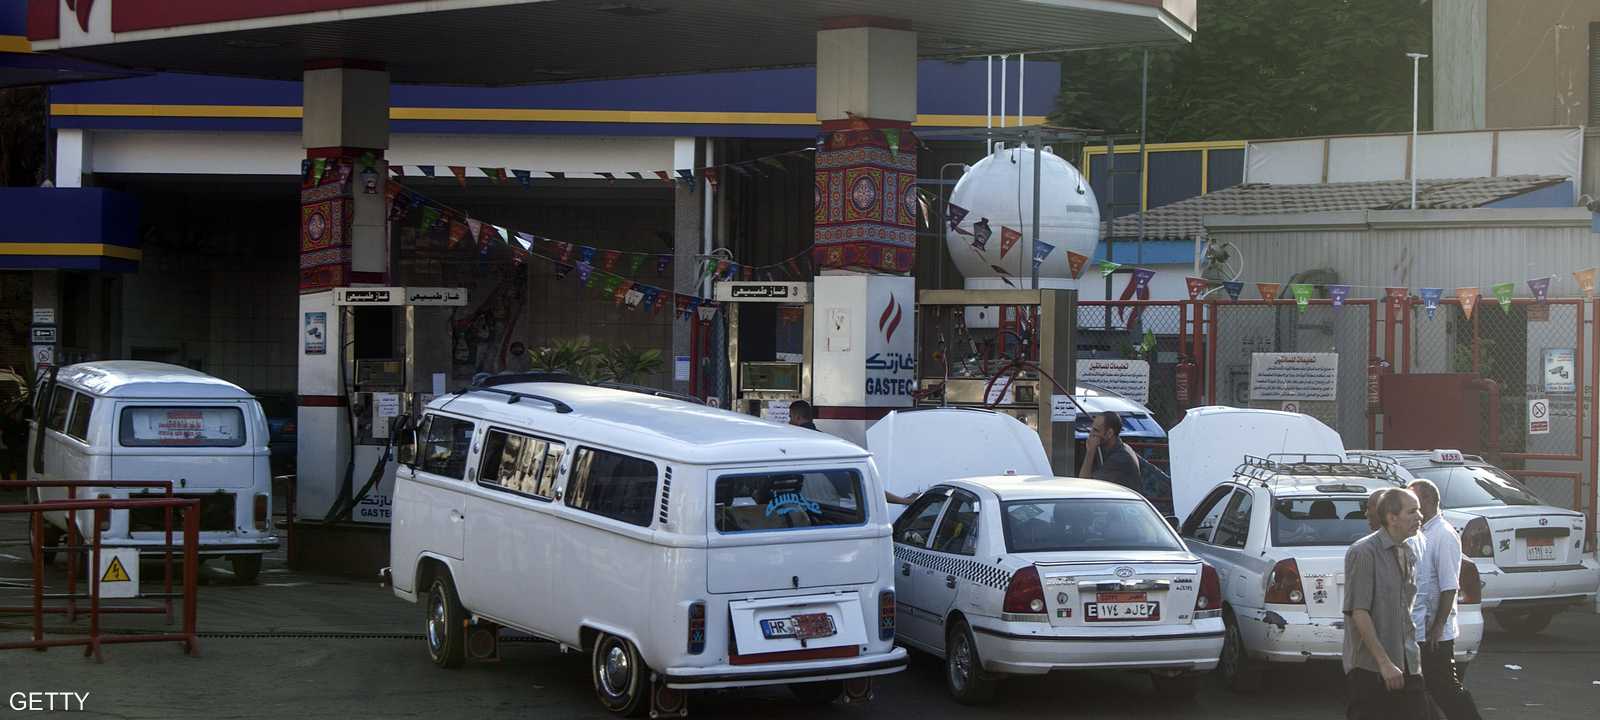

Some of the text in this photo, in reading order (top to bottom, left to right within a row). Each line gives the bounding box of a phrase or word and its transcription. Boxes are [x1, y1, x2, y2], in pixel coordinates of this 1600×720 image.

[442, 291, 460, 303] غاز
[768, 286, 786, 297] غاز
[791, 285, 799, 297] 3
[866, 352, 914, 374] غازتك
[866, 377, 913, 396] GASTEC
[1087, 604, 1098, 617] E
[768, 620, 787, 634] HR
